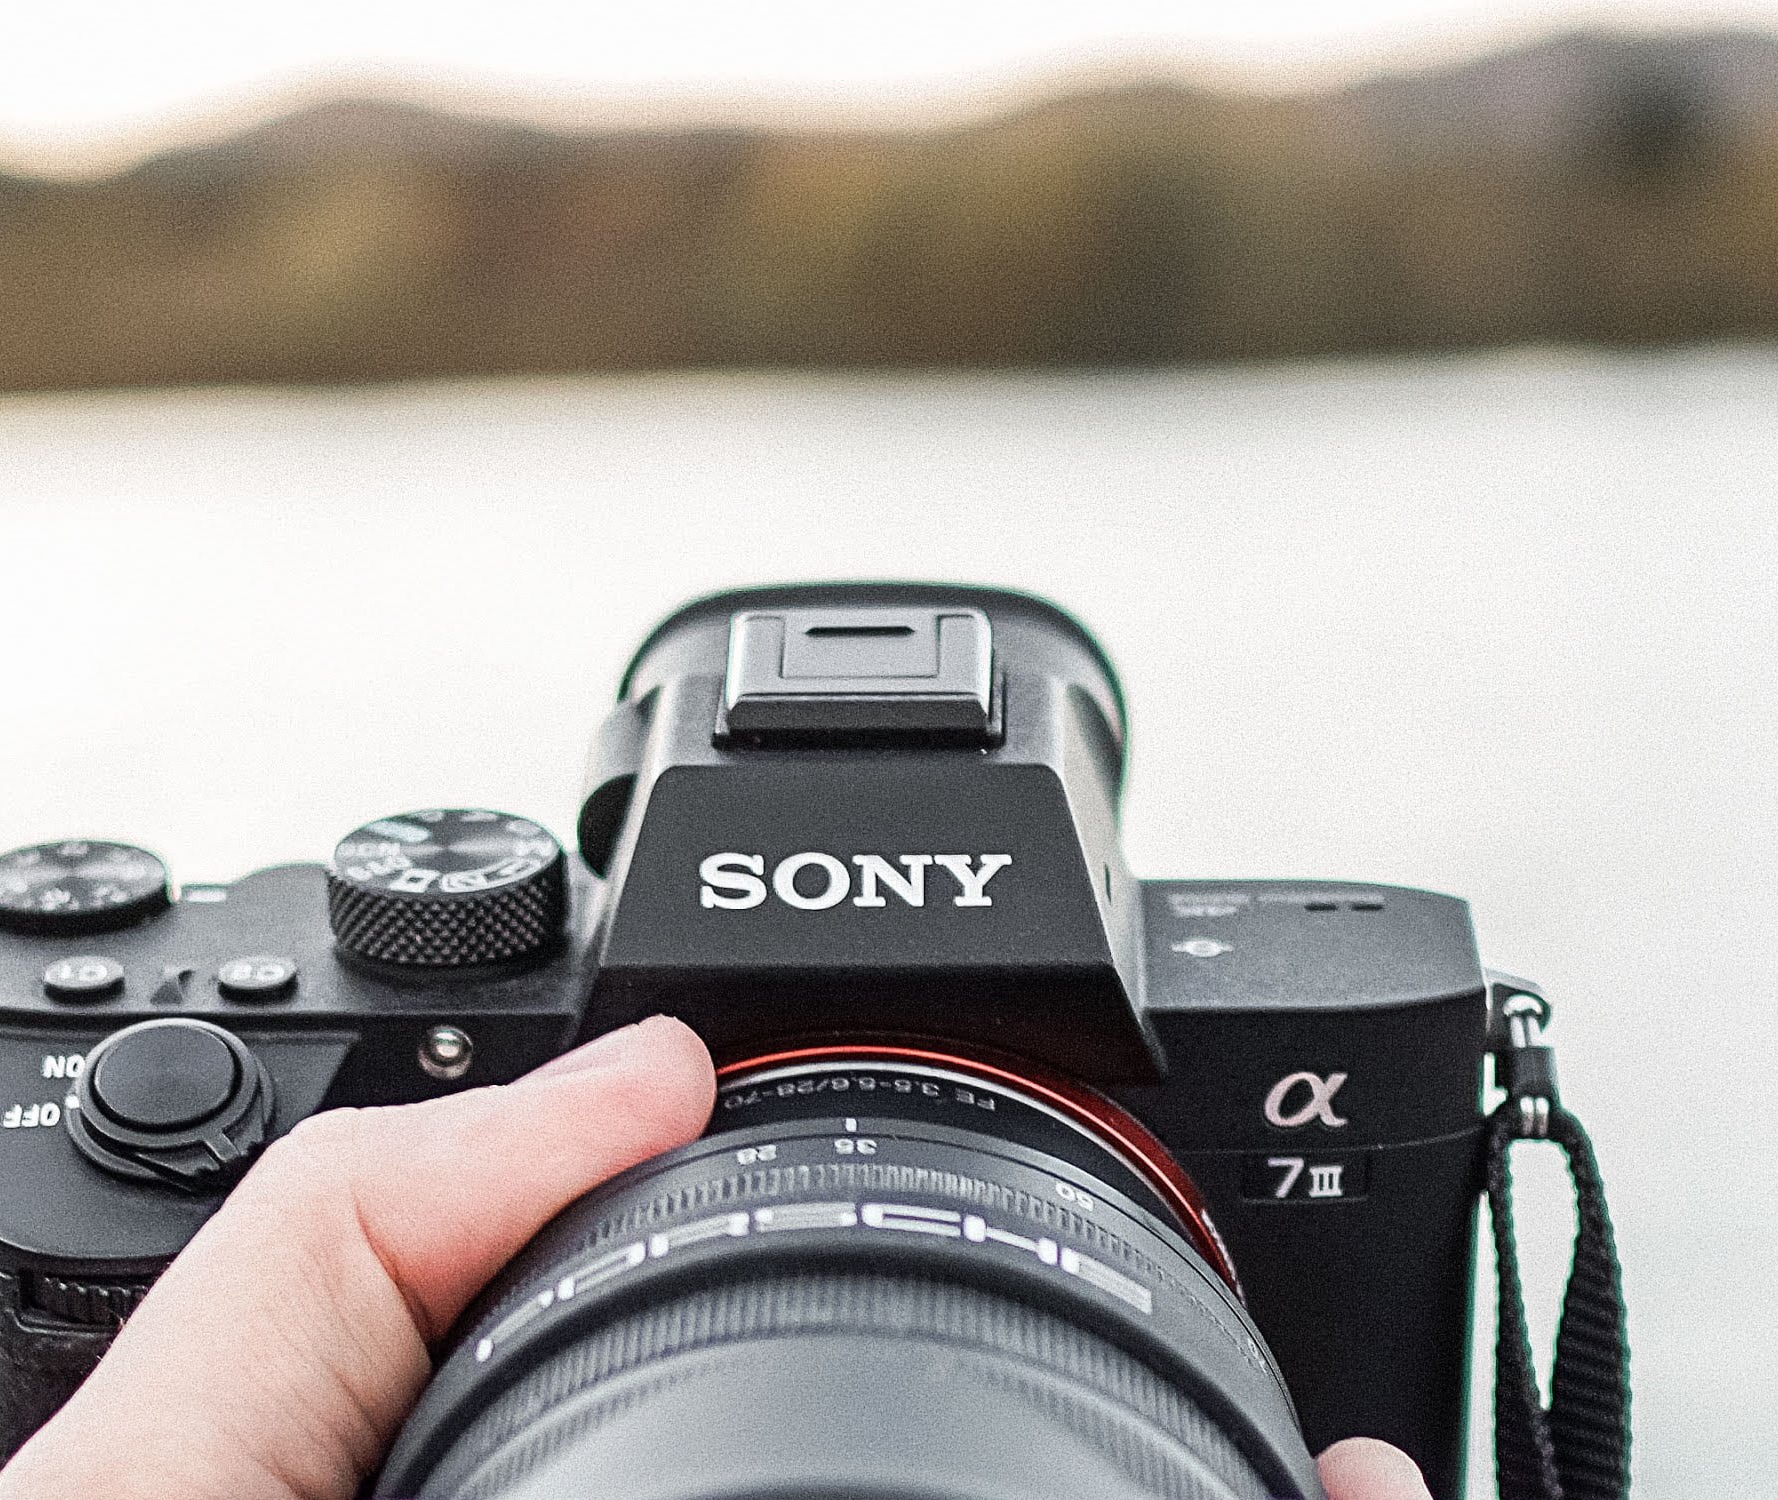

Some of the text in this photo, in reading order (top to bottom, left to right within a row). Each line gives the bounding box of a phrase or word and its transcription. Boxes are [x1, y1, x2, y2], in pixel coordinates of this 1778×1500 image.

[699, 852, 1013, 911] SONY
[42, 1053, 86, 1079] ON
[954, 1086, 997, 1112] FE
[2, 1102, 61, 1129] OFF
[735, 1144, 777, 1166] 28
[834, 1138, 877, 1155] 35
